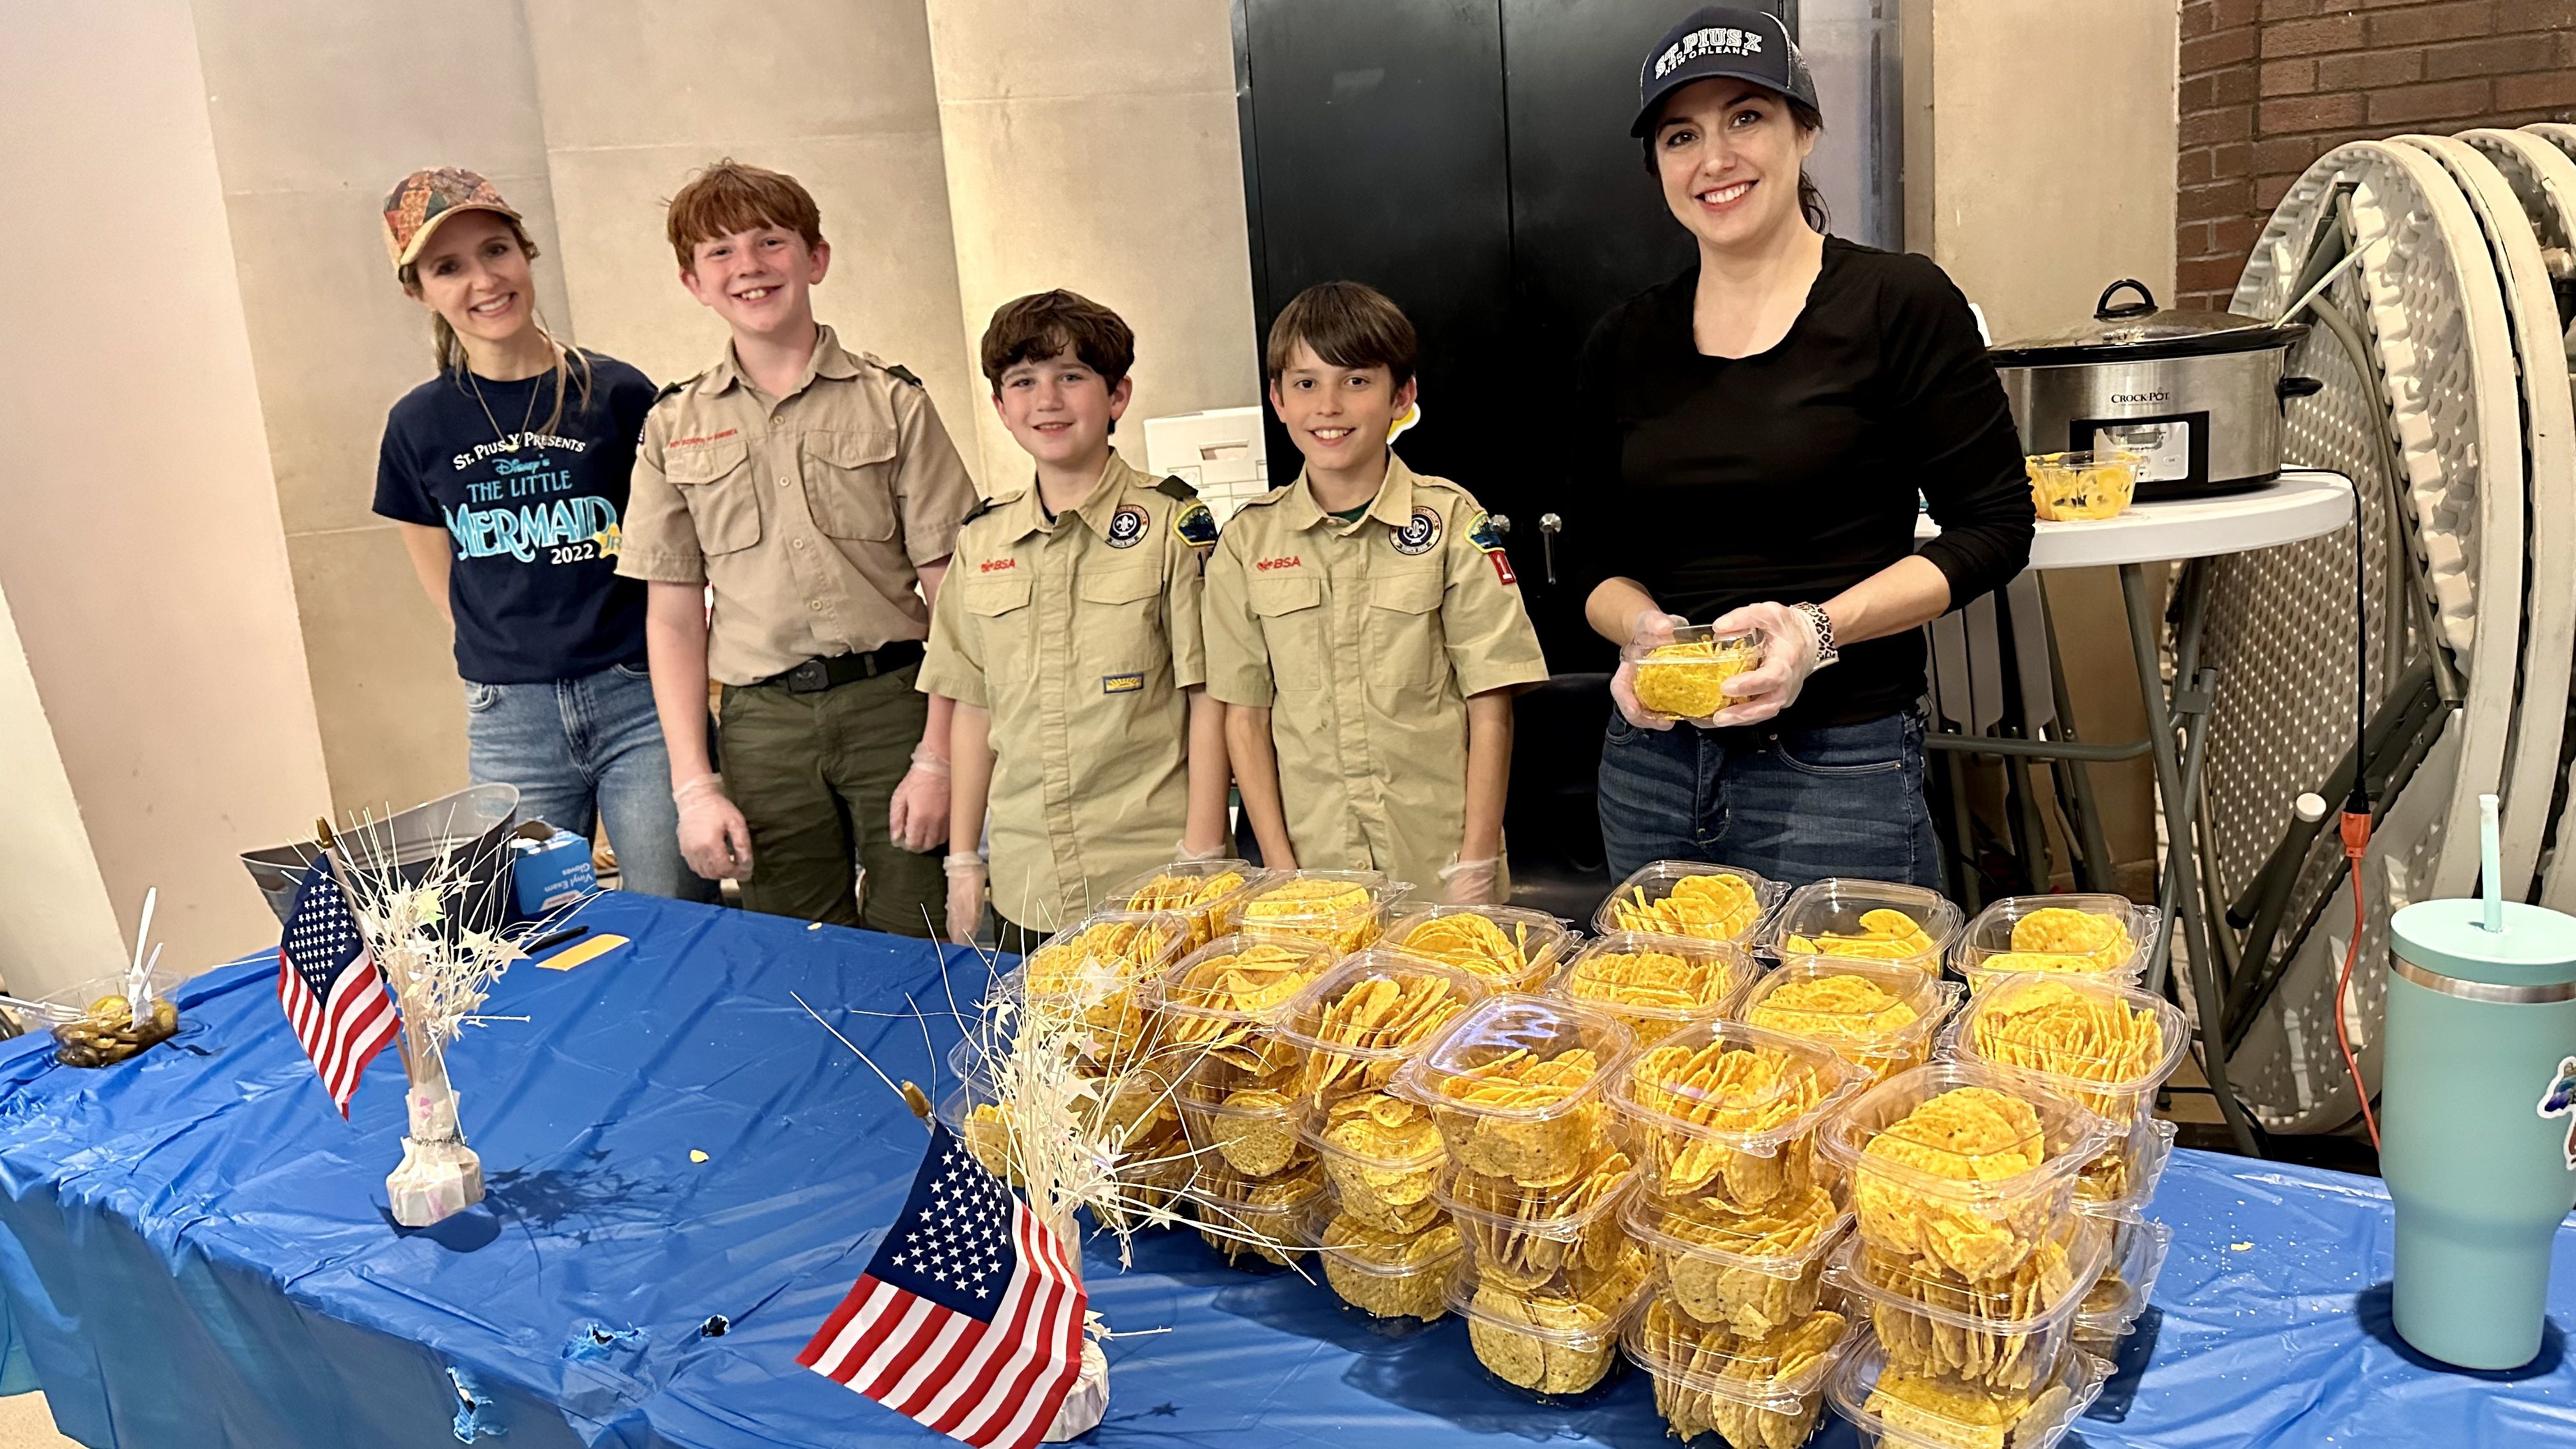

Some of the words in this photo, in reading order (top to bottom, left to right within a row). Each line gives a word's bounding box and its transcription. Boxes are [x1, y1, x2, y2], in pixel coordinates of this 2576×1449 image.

[1655, 42, 1683, 80] ST.
[1682, 27, 1742, 55] PIUS
[1744, 31, 1762, 53] X
[1664, 55, 1686, 76] NEW
[1689, 46, 1749, 59] ORLEANS
[473, 440, 505, 461] PIUS
[524, 431, 586, 453] PRESENTS
[466, 480, 504, 503] THE
[511, 470, 572, 497] LITTLE
[442, 496, 617, 563] MERMAID
[551, 544, 594, 565] 2022
[993, 557, 1015, 570] BSA
[1273, 555, 1301, 569] BSA
[562, 862, 590, 876] Gloves
[544, 880, 569, 893] Exam
[569, 873, 594, 887] Vinyl
